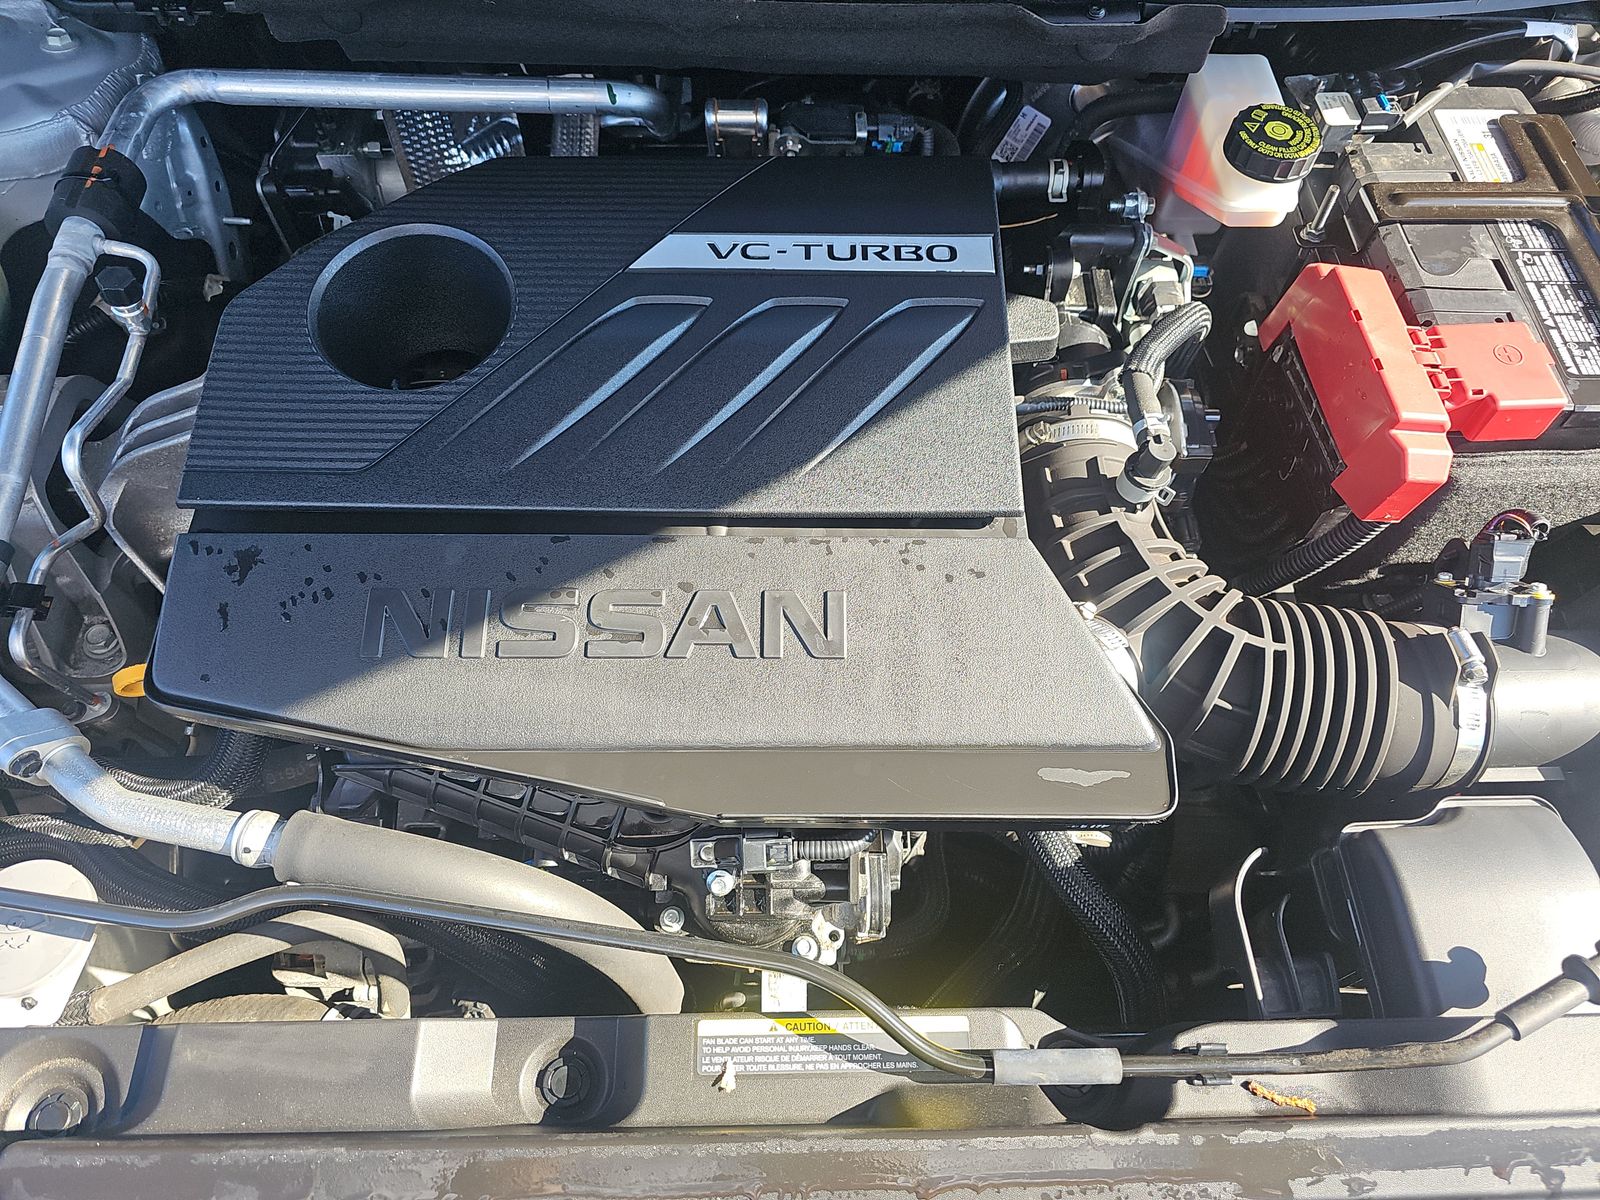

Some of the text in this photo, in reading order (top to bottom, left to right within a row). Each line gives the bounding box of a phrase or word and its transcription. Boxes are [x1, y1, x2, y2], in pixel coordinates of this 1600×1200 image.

[1258, 141, 1278, 152] CLEAN
[1258, 147, 1273, 156] DOT3
[706, 242, 958, 262] VC-TURBO
[360, 588, 846, 659] NISSAN
[785, 1022, 830, 1032] CAUTION
[791, 1053, 827, 1062] DÉMARRER
